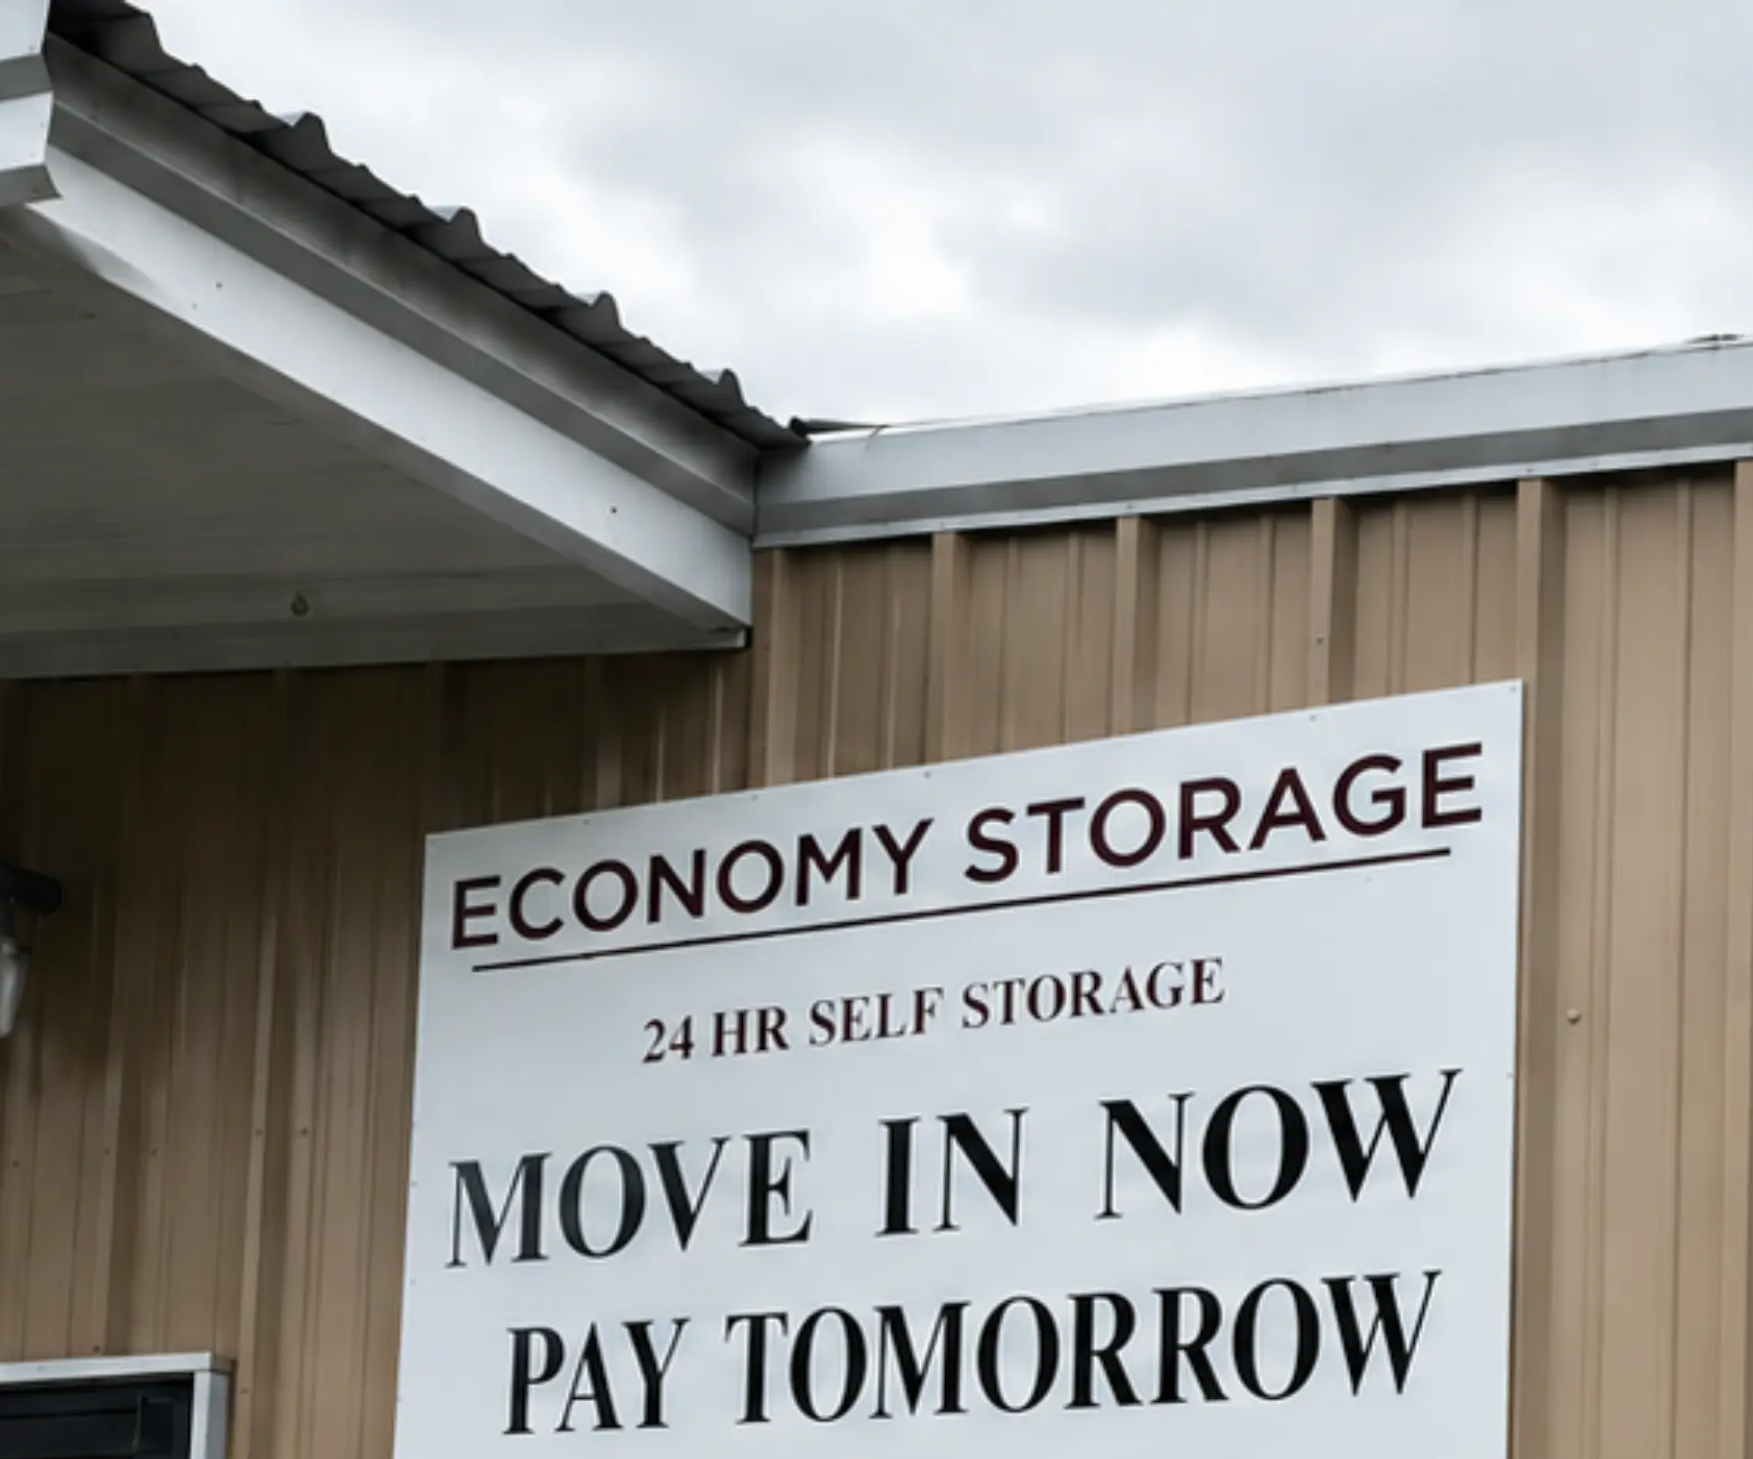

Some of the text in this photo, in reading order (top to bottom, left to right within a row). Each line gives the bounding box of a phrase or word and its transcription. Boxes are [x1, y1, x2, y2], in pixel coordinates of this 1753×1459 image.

[450, 742, 1483, 951] ECONOMY STORAGE
[642, 958, 1226, 1064] 24 HR SELF STORAGE
[446, 1068, 1463, 1268] MOVE IN NOW
[502, 1270, 1443, 1435] PAY TOMORROW
